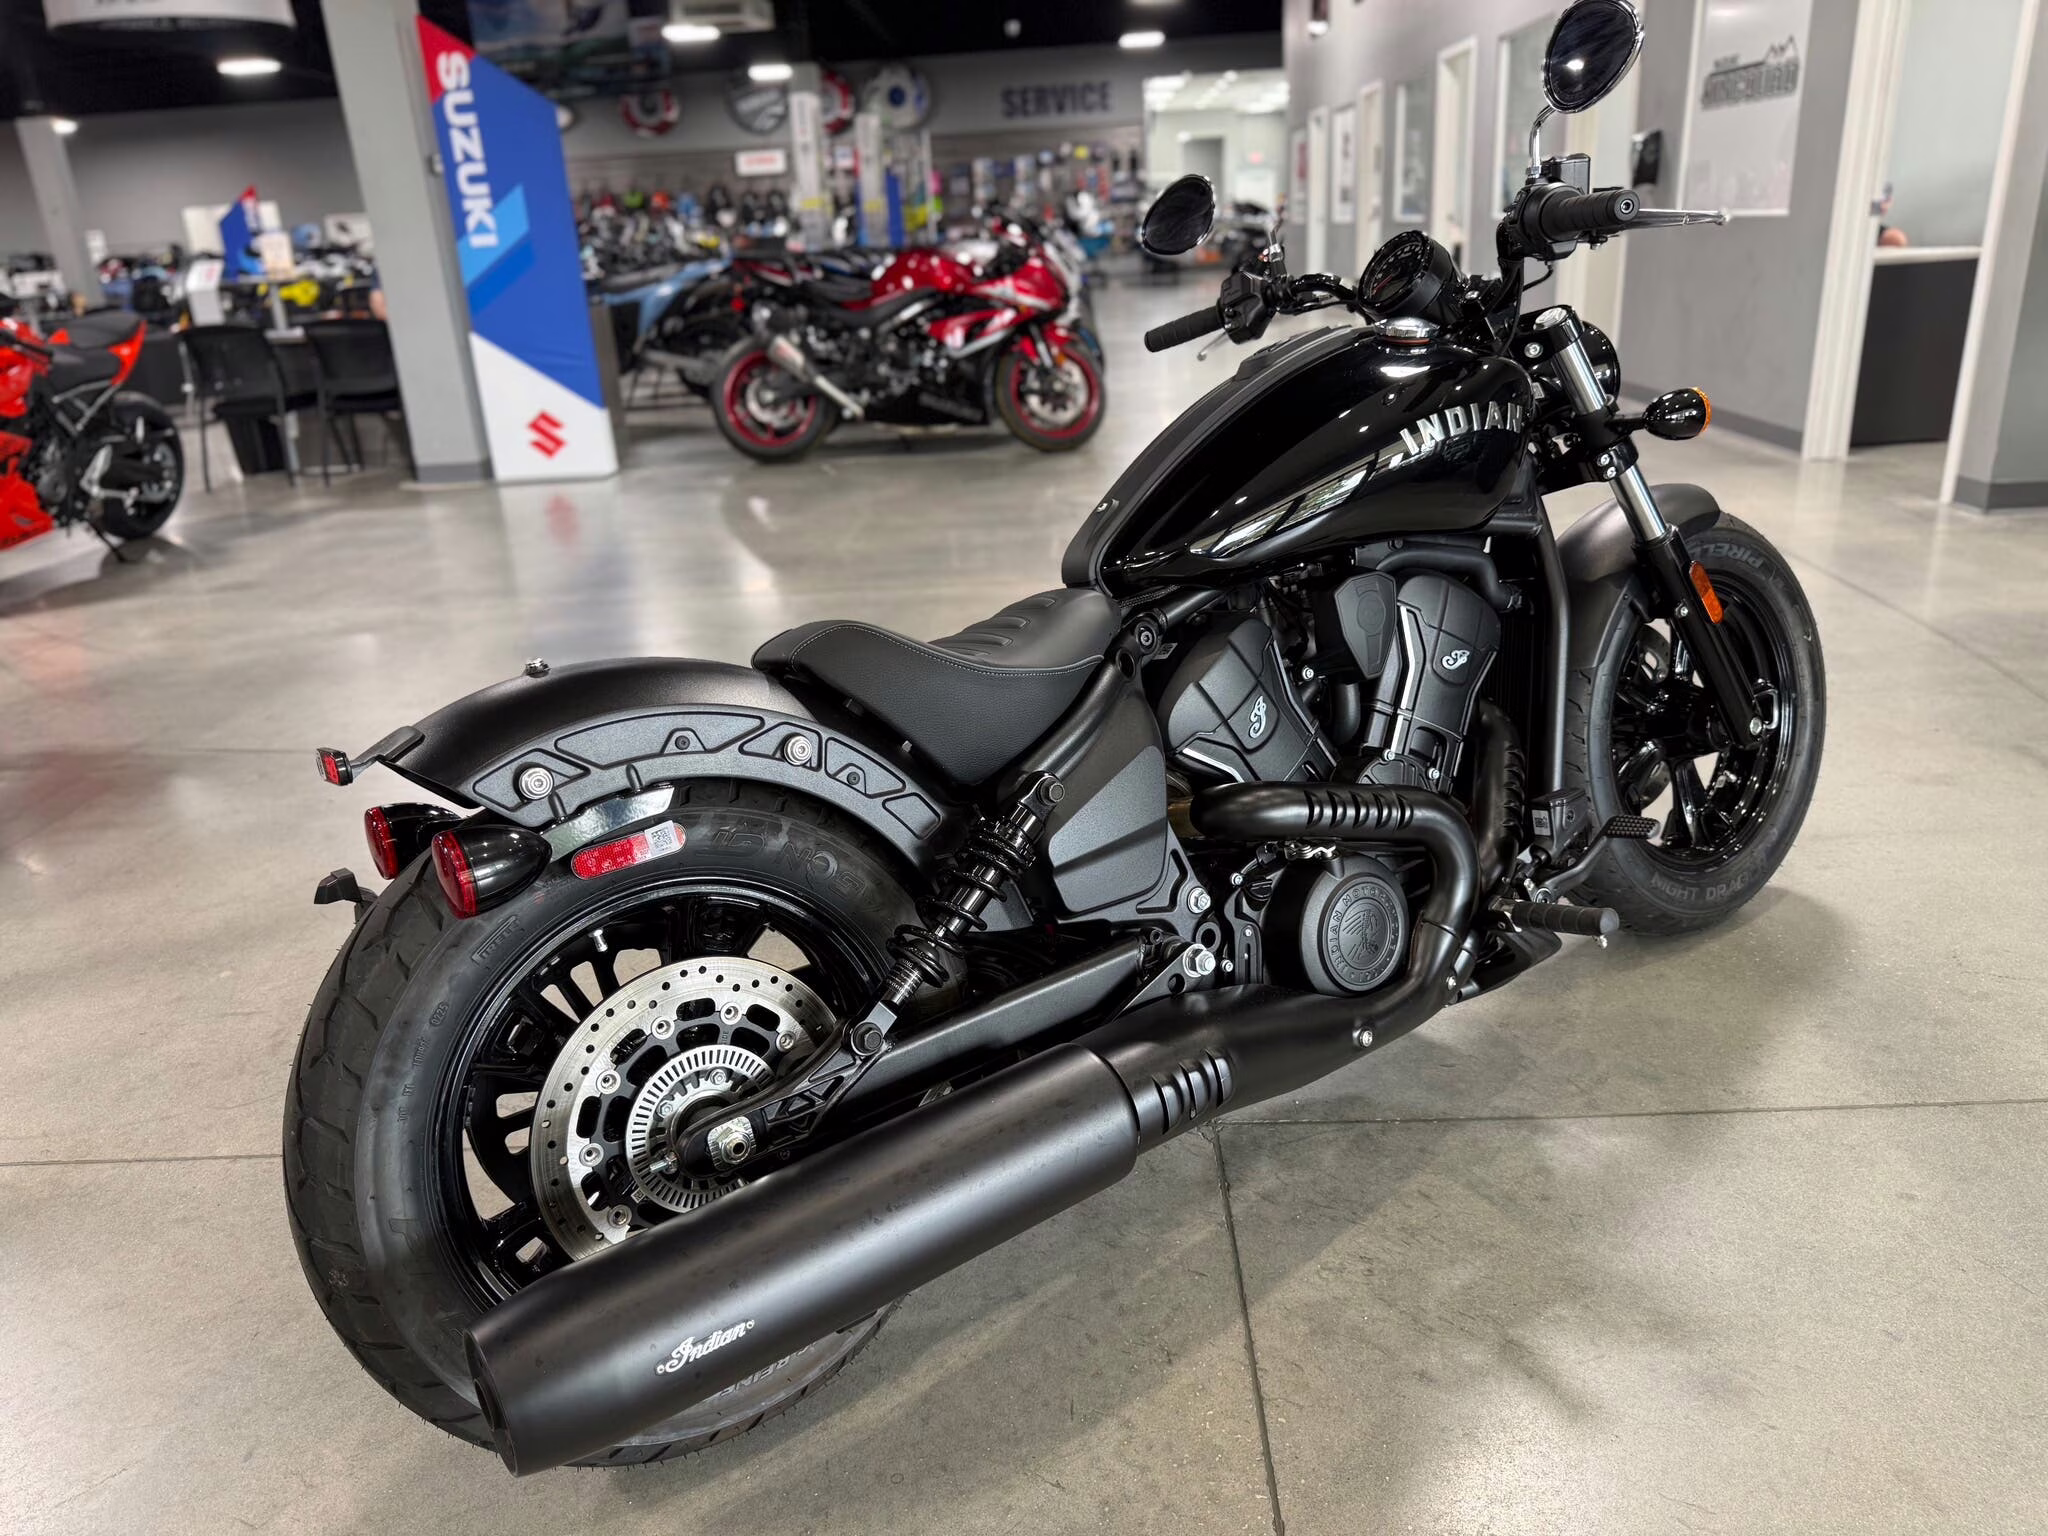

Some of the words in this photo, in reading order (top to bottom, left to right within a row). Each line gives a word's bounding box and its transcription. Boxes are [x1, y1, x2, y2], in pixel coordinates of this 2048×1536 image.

[1001, 82, 1112, 119] SERVICE
[436, 51, 499, 249] SUZUKI
[1400, 401, 1522, 456] INDIAN
[665, 1322, 747, 1373] Indian
